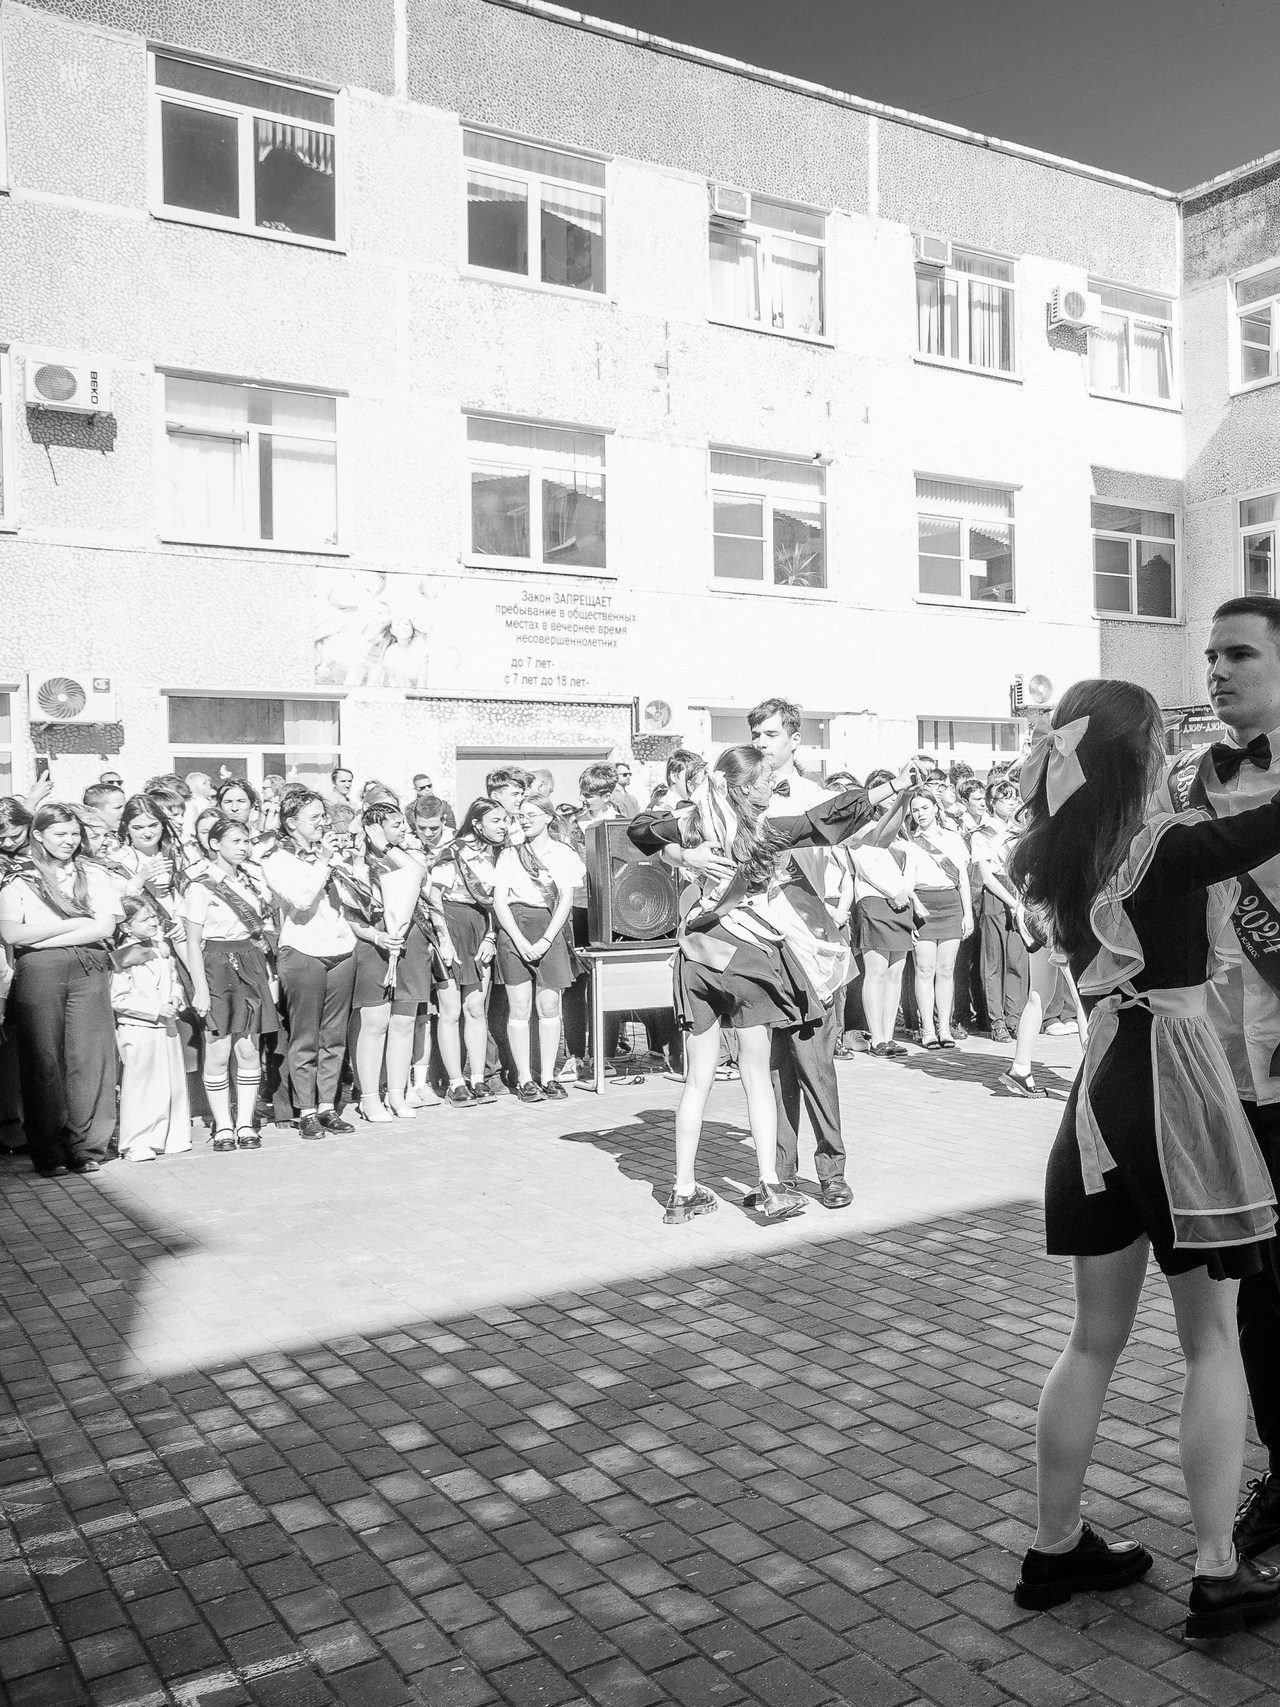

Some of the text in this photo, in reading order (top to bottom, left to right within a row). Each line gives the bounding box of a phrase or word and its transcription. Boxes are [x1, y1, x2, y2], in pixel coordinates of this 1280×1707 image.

[90, 371, 98, 404] BEKO
[521, 589, 613, 608] Закон ЗАПРЕЩАЕТ
[495, 603, 636, 622] пребывание в общественных
[505, 619, 628, 636] местах в вечернее время
[516, 634, 618, 648] несовершеннолетних
[510, 658, 524, 669] до
[526, 656, 532, 667] 7
[504, 675, 510, 685] с
[512, 673, 518, 684] 7
[521, 675, 538, 686] лет
[540, 676, 554, 688] до
[556, 674, 567, 687] 18
[1241, 936, 1260, 959] класс
